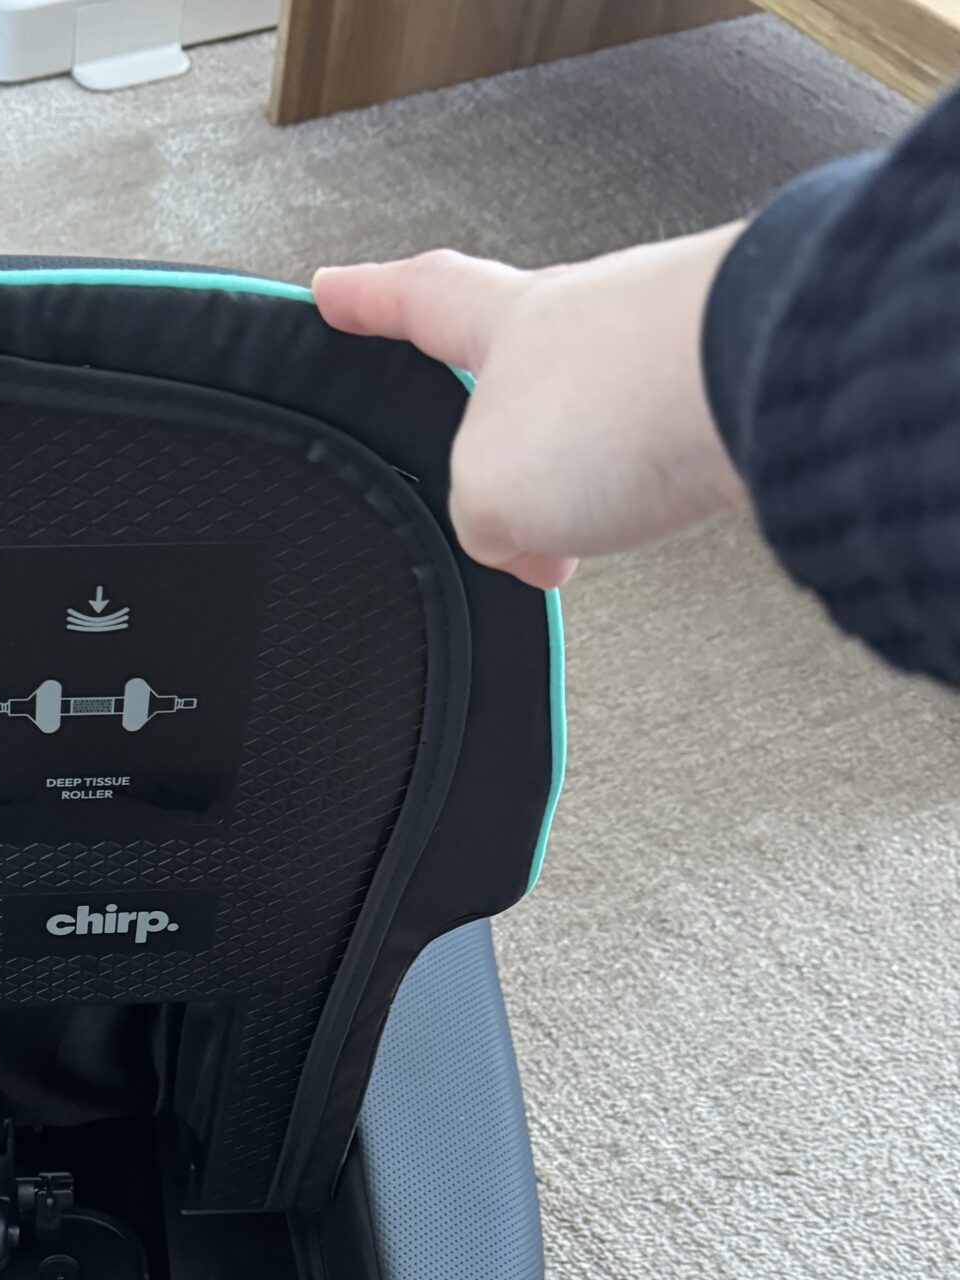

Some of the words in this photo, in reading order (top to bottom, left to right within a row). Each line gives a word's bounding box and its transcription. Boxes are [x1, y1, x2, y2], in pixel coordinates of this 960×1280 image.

[46, 777, 81, 787] DEEP
[84, 776, 130, 787] TISSUE
[61, 789, 113, 800] ROLLER
